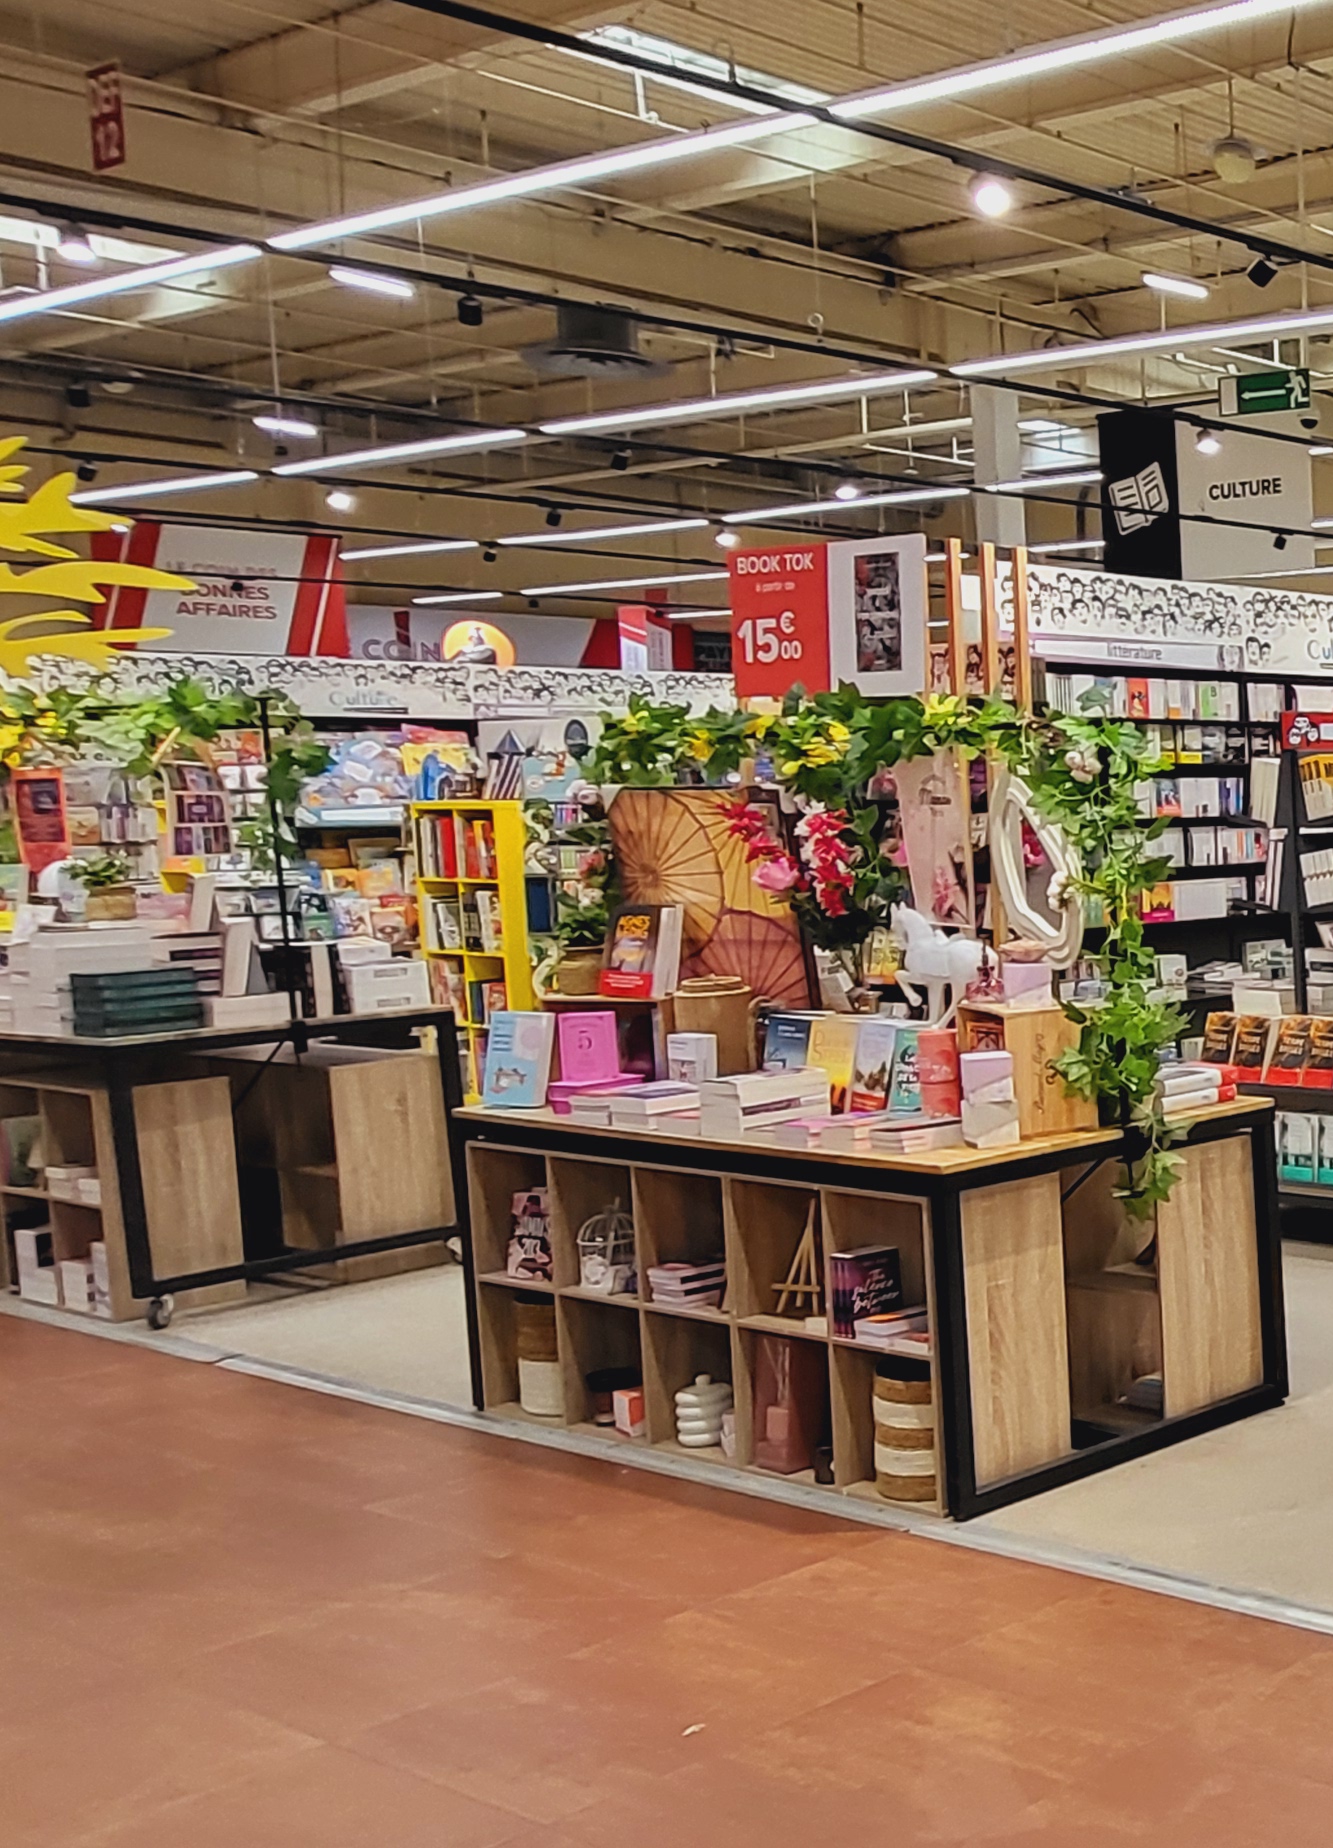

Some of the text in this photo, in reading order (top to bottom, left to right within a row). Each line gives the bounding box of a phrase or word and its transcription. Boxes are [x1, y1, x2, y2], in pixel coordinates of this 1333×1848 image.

[1208, 477, 1283, 502] CULTURE
[736, 552, 815, 575] BOOK TOK
[176, 601, 278, 620] AFFAIRES
[779, 611, 796, 634] €
[737, 617, 781, 664] 15
[780, 640, 803, 660] 00
